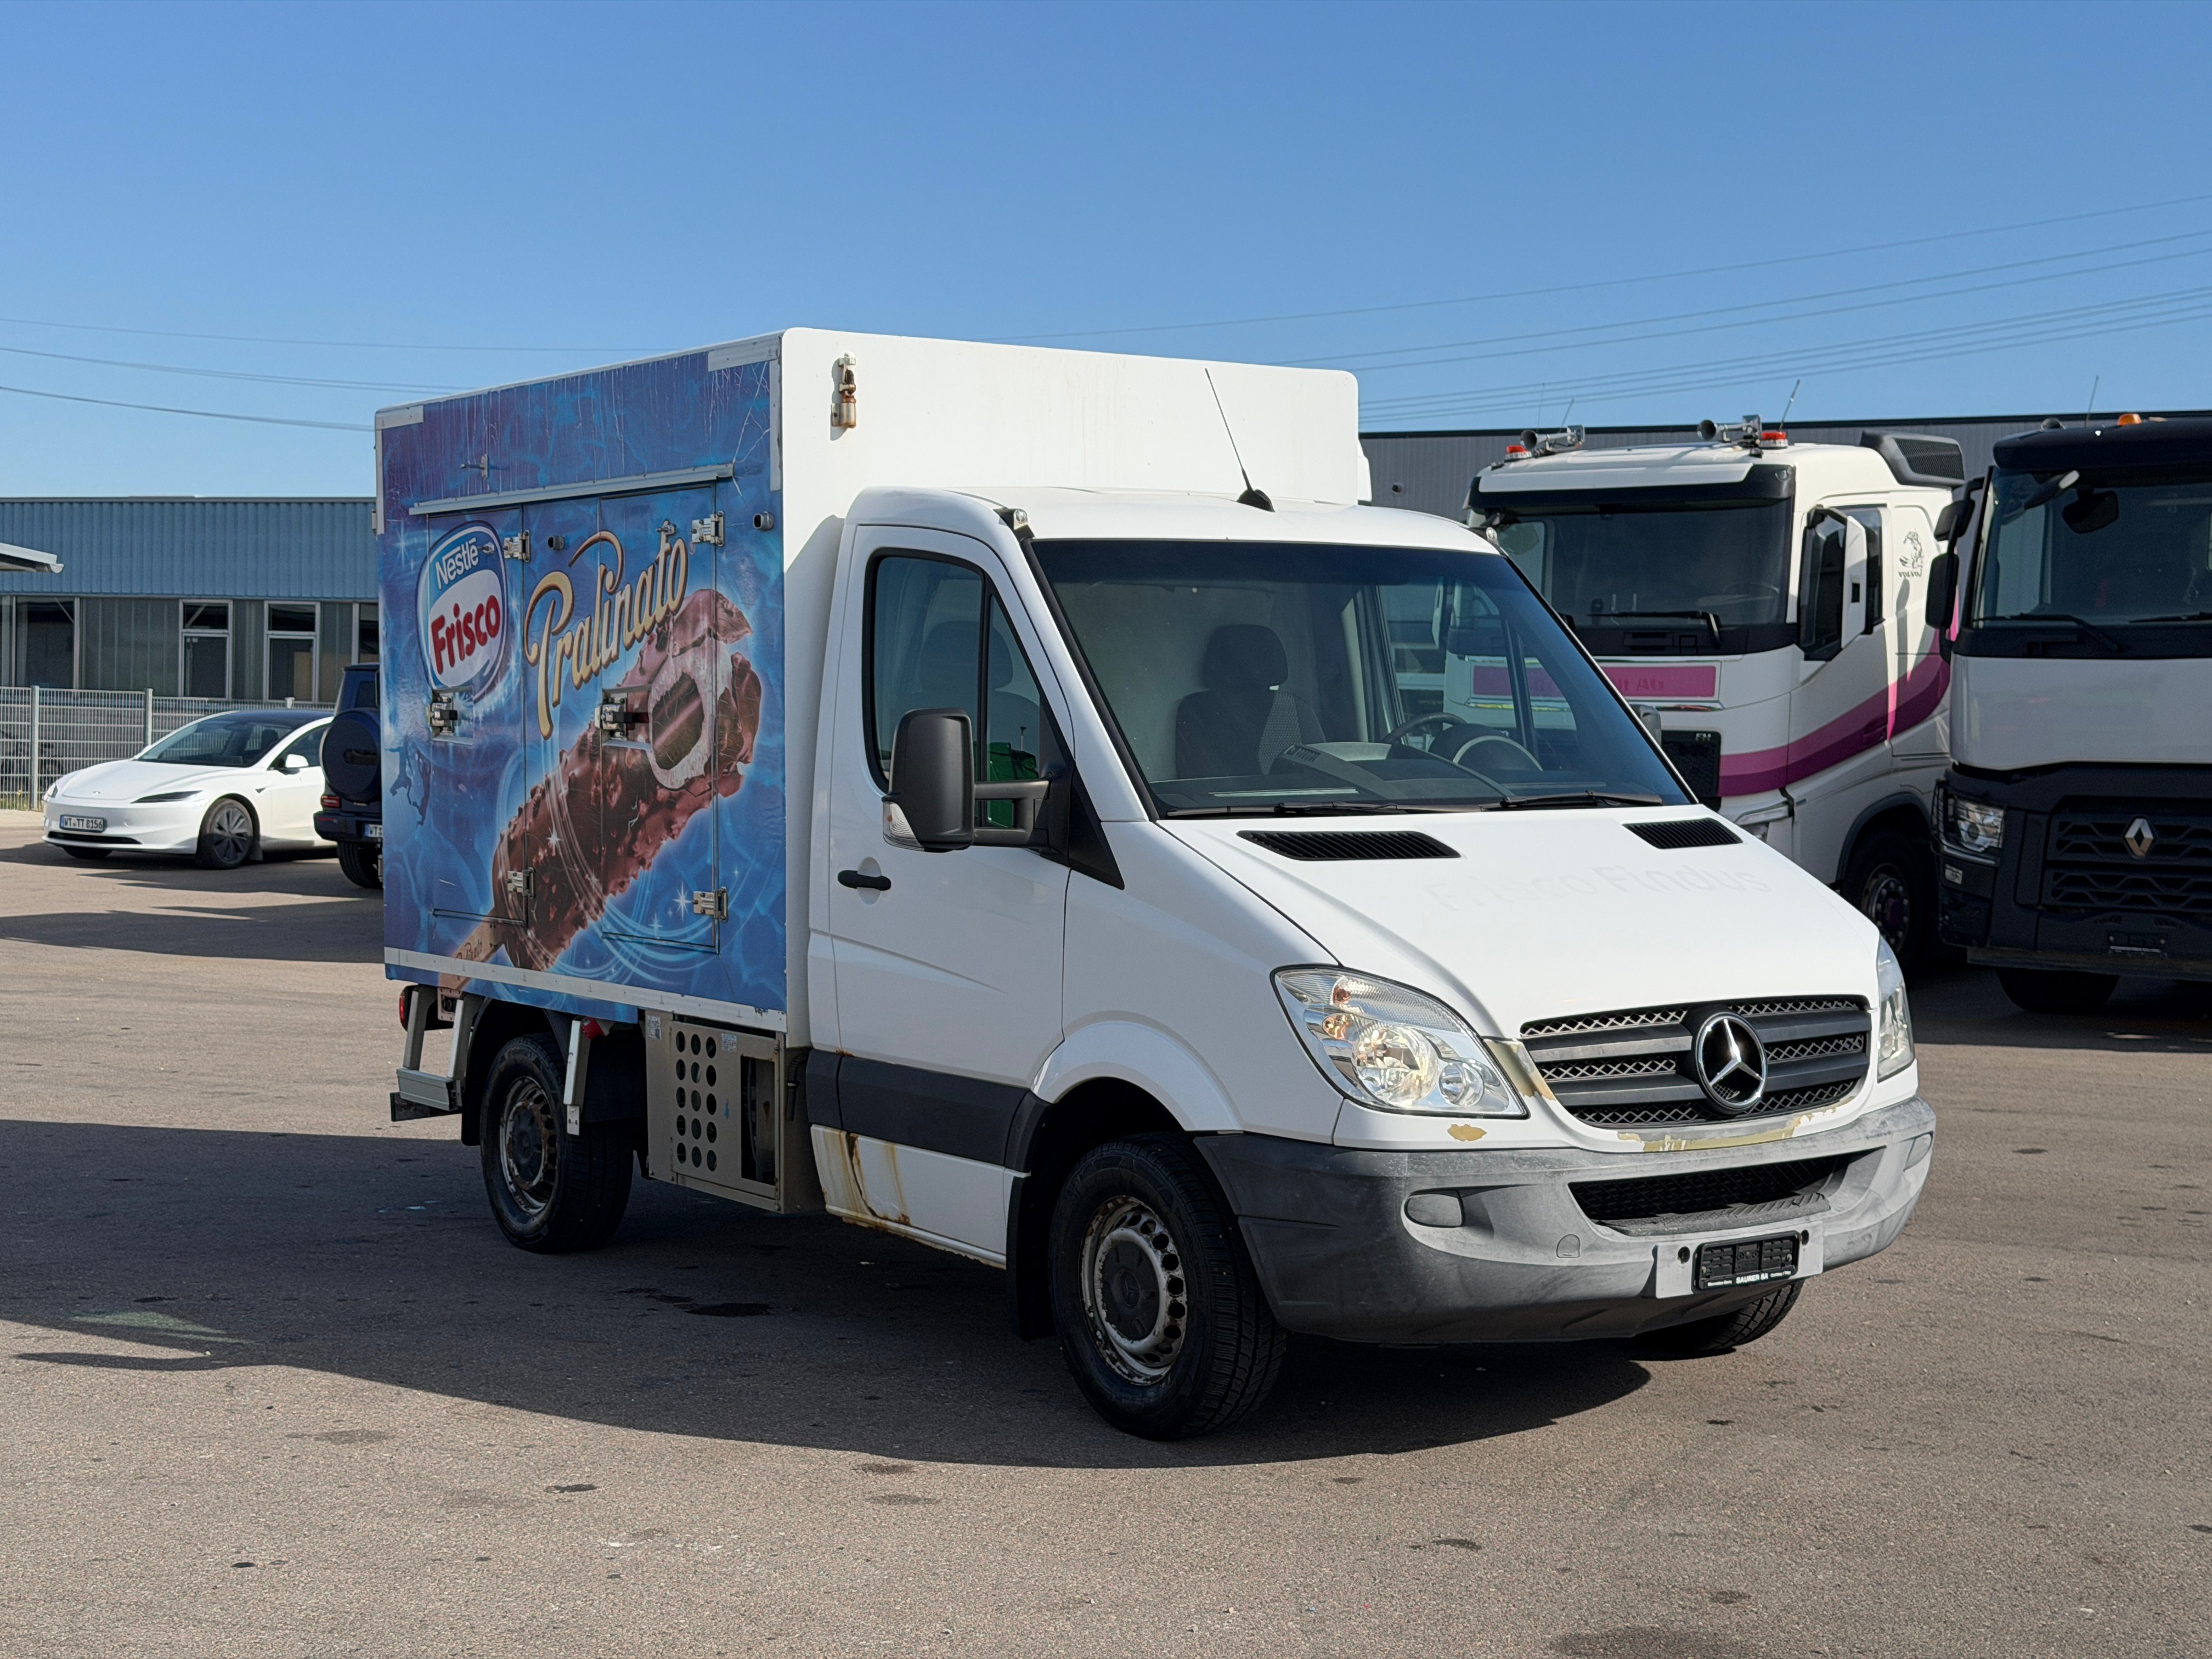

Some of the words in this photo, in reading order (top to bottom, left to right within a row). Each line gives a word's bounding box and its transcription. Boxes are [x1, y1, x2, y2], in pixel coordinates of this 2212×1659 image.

[435, 537, 478, 590] Nestlé
[431, 595, 500, 675] Frisco
[524, 520, 689, 741] Pralinato
[1592, 864, 1773, 894] Findus
